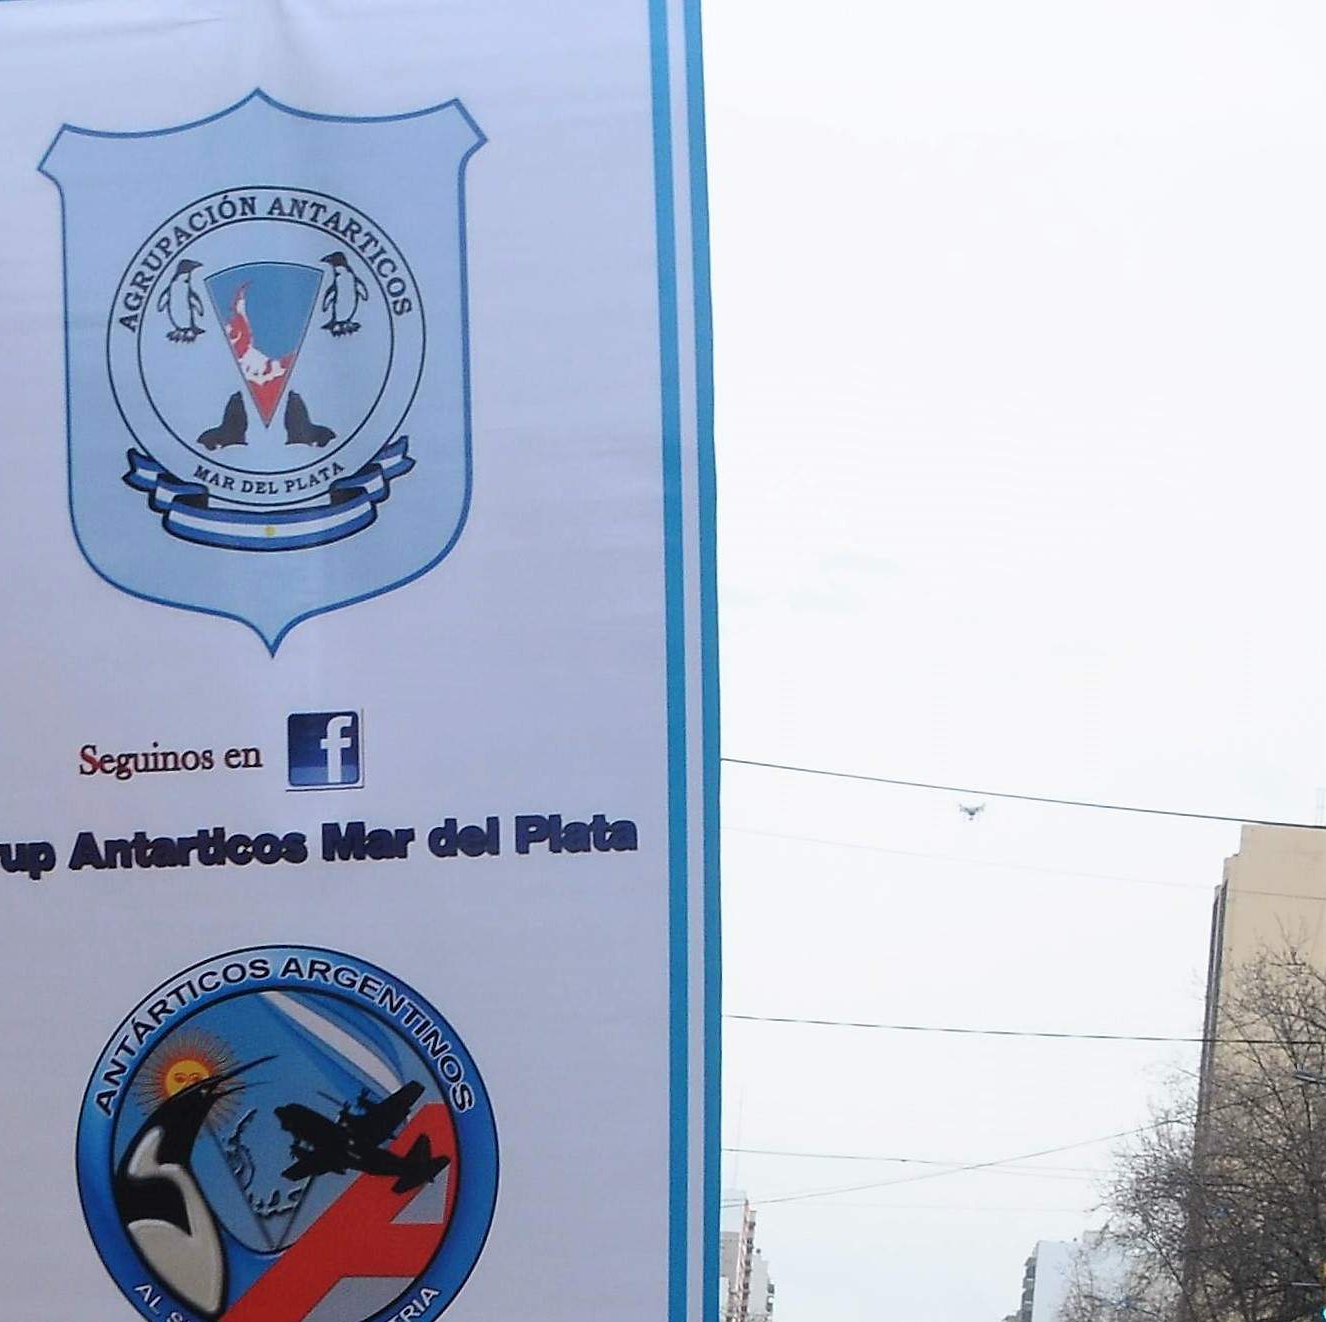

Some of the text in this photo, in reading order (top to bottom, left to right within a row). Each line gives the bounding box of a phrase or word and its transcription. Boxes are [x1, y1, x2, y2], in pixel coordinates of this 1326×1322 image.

[118, 195, 414, 334] AGRUPACIÓN ANTARTICOS
[192, 460, 347, 496] MAR DEL PLATA
[78, 741, 263, 780] Seguinos en
[68, 827, 308, 871] Antarticos
[321, 819, 416, 862] Mar
[428, 817, 500, 858] del
[514, 813, 639, 854] Plata
[93, 955, 475, 1118] ANTÁRTICOS ARGENTINOS
[135, 1283, 163, 1315] AL
